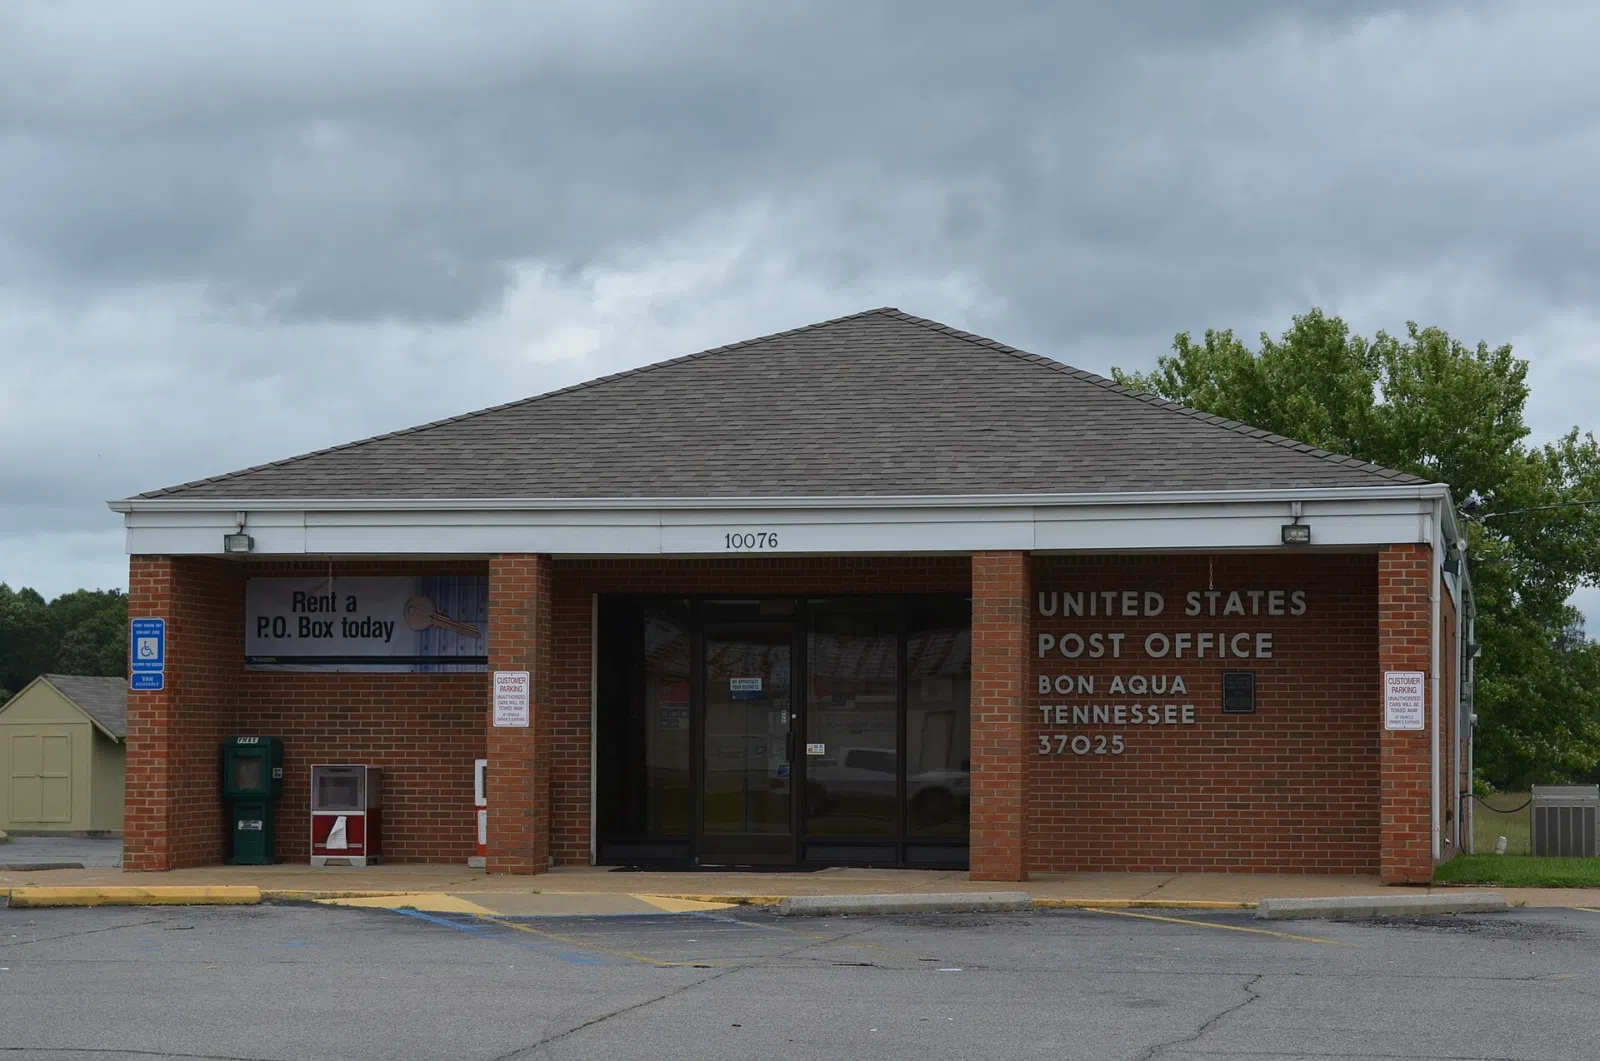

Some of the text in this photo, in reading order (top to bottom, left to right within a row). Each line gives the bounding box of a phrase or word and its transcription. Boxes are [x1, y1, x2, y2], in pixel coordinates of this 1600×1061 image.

[724, 532, 778, 548] 10076
[292, 590, 357, 612] Rent a
[1038, 590, 1307, 617] UNITED STATES
[256, 616, 395, 643] P.O. Box today
[1038, 632, 1273, 658] POST OFFICE
[1038, 674, 1188, 695] BON AQUA
[1039, 704, 1195, 725] TENNESSEE
[1038, 735, 1125, 755] 37025
